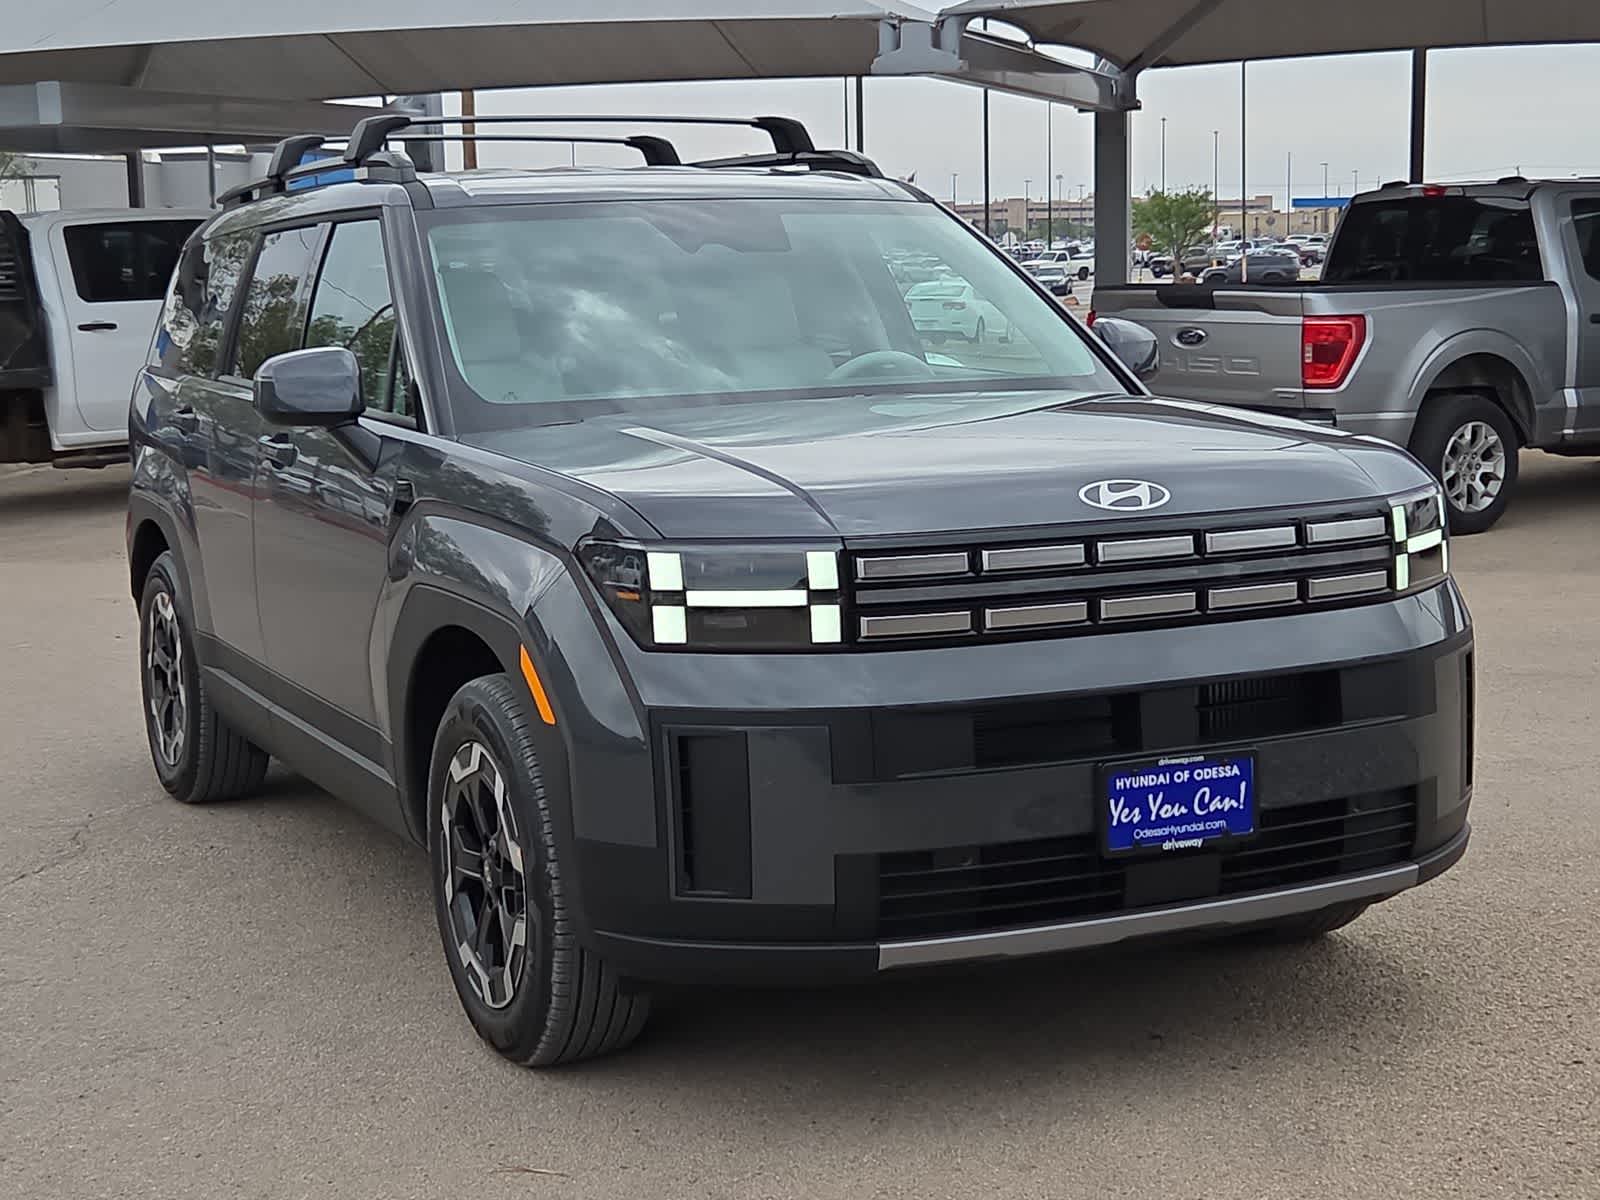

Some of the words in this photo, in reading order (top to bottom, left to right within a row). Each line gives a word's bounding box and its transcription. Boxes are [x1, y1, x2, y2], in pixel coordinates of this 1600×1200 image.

[1115, 772, 1170, 790] HYUNDAI
[1173, 770, 1190, 783] OF
[1193, 764, 1240, 780] ODESSA
[1109, 796, 1142, 826] Yes
[1148, 792, 1188, 821] You
[1193, 781, 1246, 815] Can!
[1133, 819, 1226, 839] OdessaHyundai.com
[1162, 838, 1203, 851] driveway
